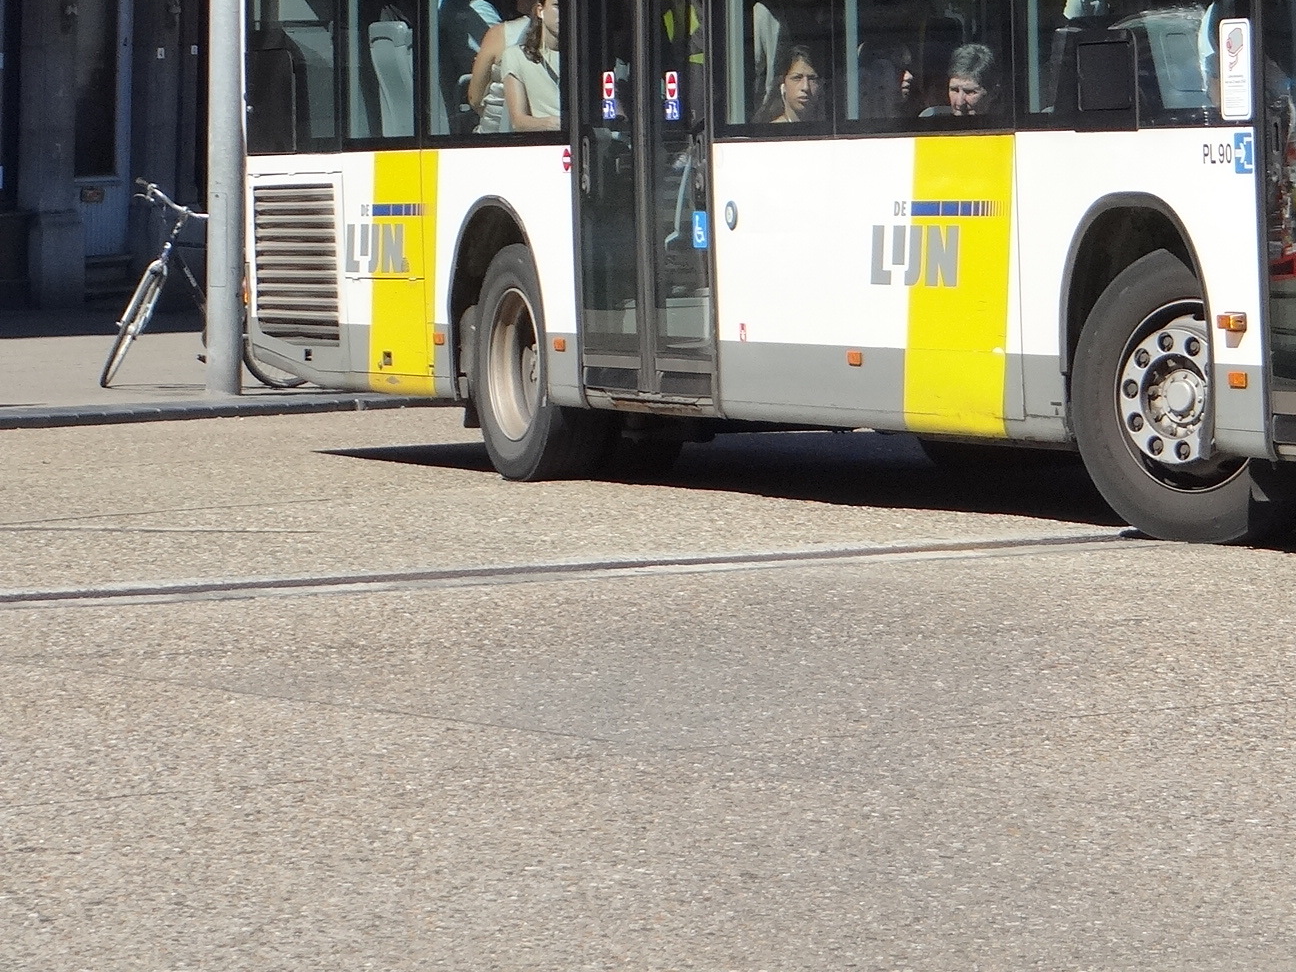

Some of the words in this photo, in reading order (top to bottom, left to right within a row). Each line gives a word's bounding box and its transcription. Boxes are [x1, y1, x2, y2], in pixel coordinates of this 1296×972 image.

[1203, 144, 1216, 164] PL
[1218, 143, 1233, 164] 90
[893, 201, 907, 216] DE
[345, 223, 404, 274] LIJN
[870, 224, 960, 287] LIJN
